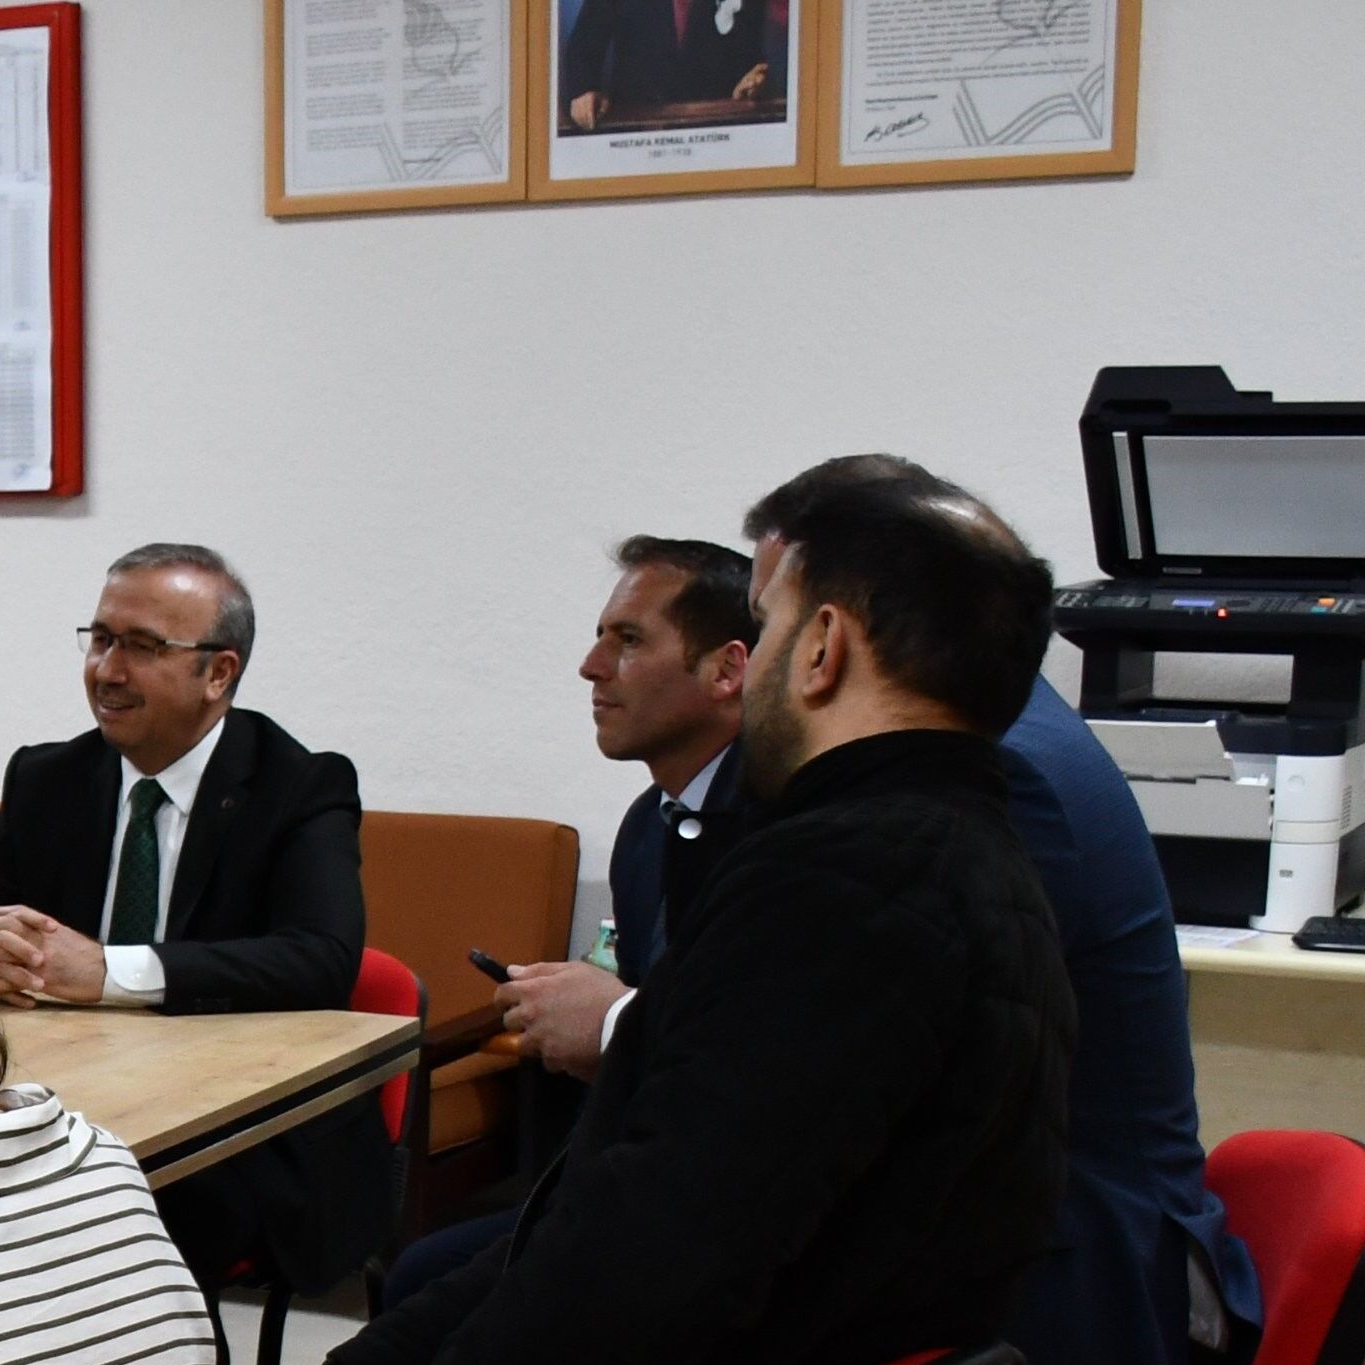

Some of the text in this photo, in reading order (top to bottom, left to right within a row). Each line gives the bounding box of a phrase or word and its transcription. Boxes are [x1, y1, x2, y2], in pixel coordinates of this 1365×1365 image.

[610, 132, 730, 148] MUSTAFA KEMAL ATATÜRK
